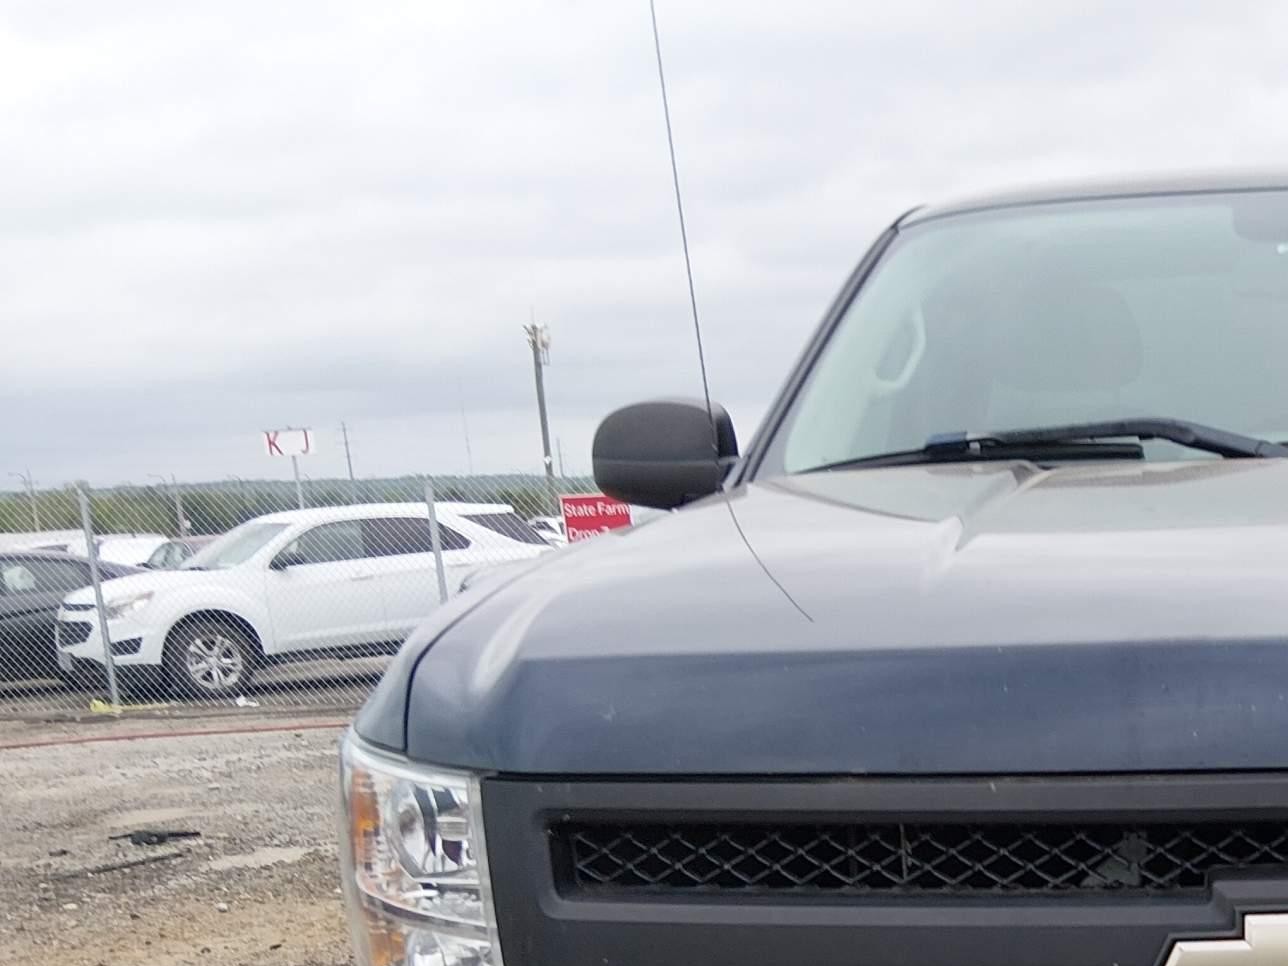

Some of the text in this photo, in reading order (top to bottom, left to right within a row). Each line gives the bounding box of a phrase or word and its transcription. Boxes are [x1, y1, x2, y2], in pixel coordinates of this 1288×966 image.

[264, 429, 310, 456] K J
[564, 501, 630, 518] State Farm
